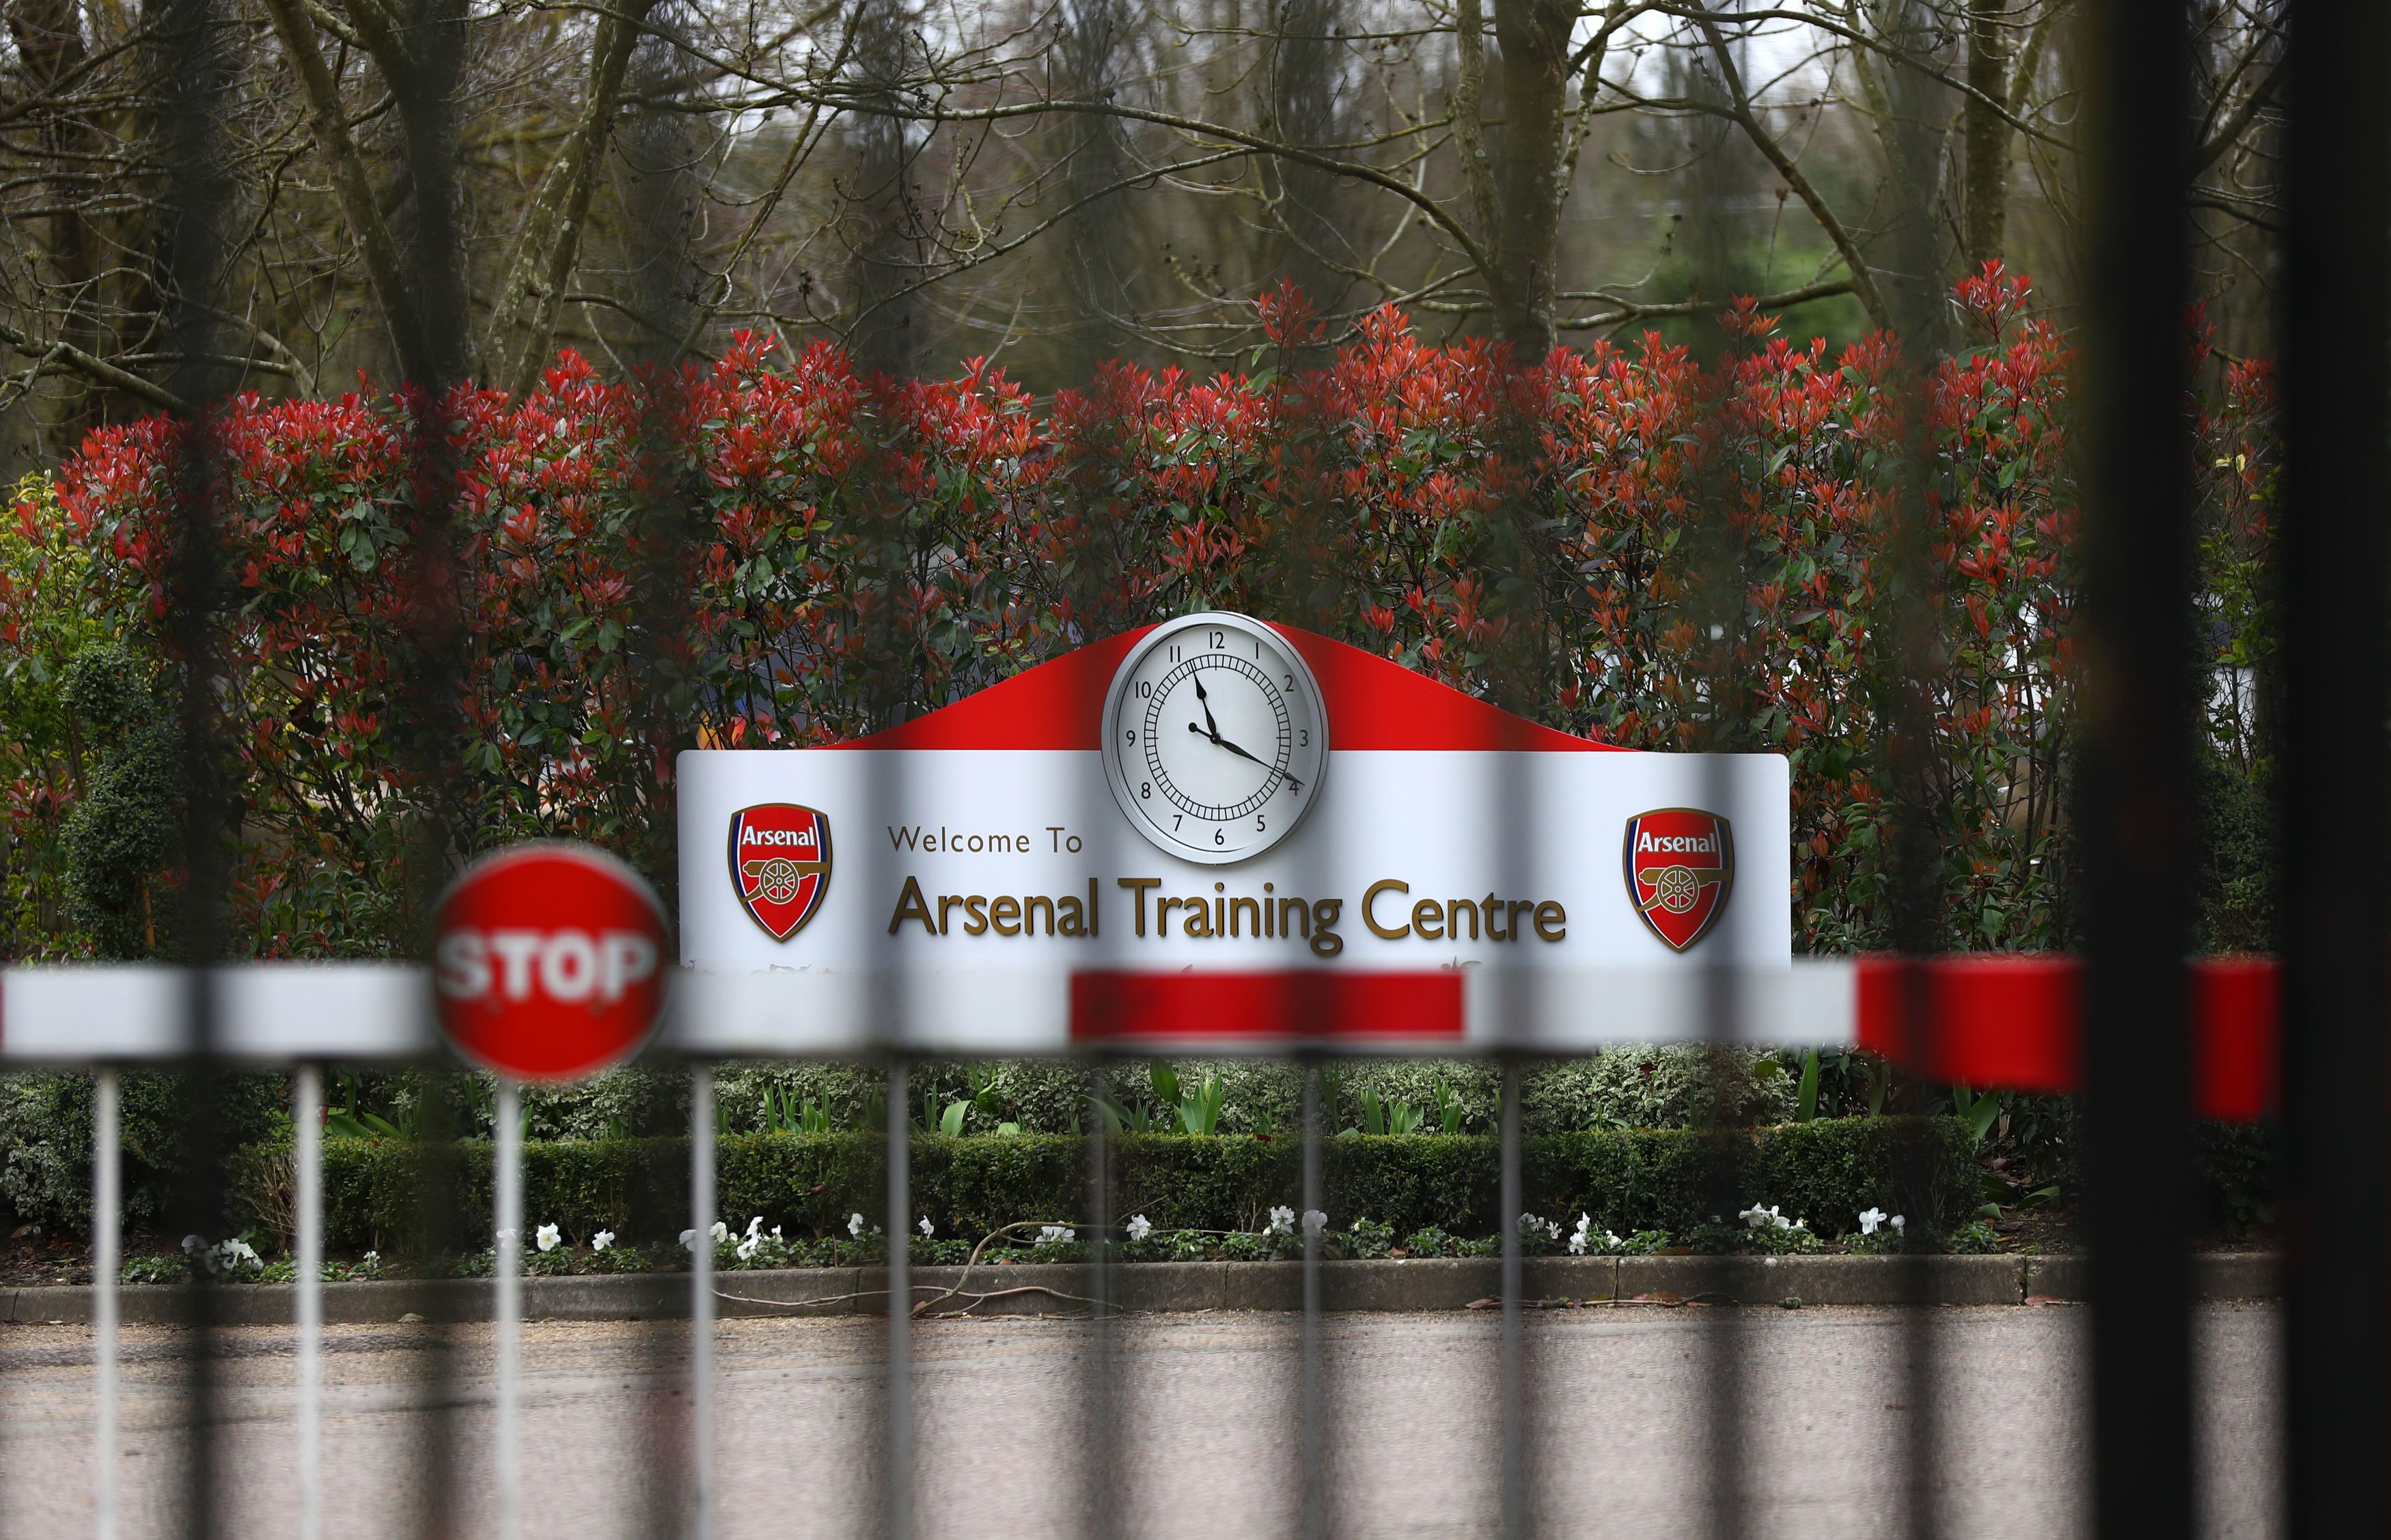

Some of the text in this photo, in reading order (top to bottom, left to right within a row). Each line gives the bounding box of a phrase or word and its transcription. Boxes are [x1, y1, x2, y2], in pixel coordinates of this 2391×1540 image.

[1209, 631, 1225, 649] 12
[1170, 645, 1180, 663] 11
[1135, 681, 1152, 699] 10
[1284, 674, 1295, 692] 2
[1126, 729, 1136, 747] 9
[1299, 729, 1309, 747] 3
[1140, 781, 1151, 799] 8
[1288, 779, 1299, 796] 4
[1173, 814, 1183, 832] 7
[1256, 814, 1266, 832] 5
[741, 824, 816, 847] Arsenal
[887, 826, 1083, 853] Welcome To
[1214, 828, 1224, 845] 6
[1636, 830, 1717, 855] Arsenal
[887, 875, 1566, 957] Arsenal Training Centre
[437, 929, 657, 1001] STOP
